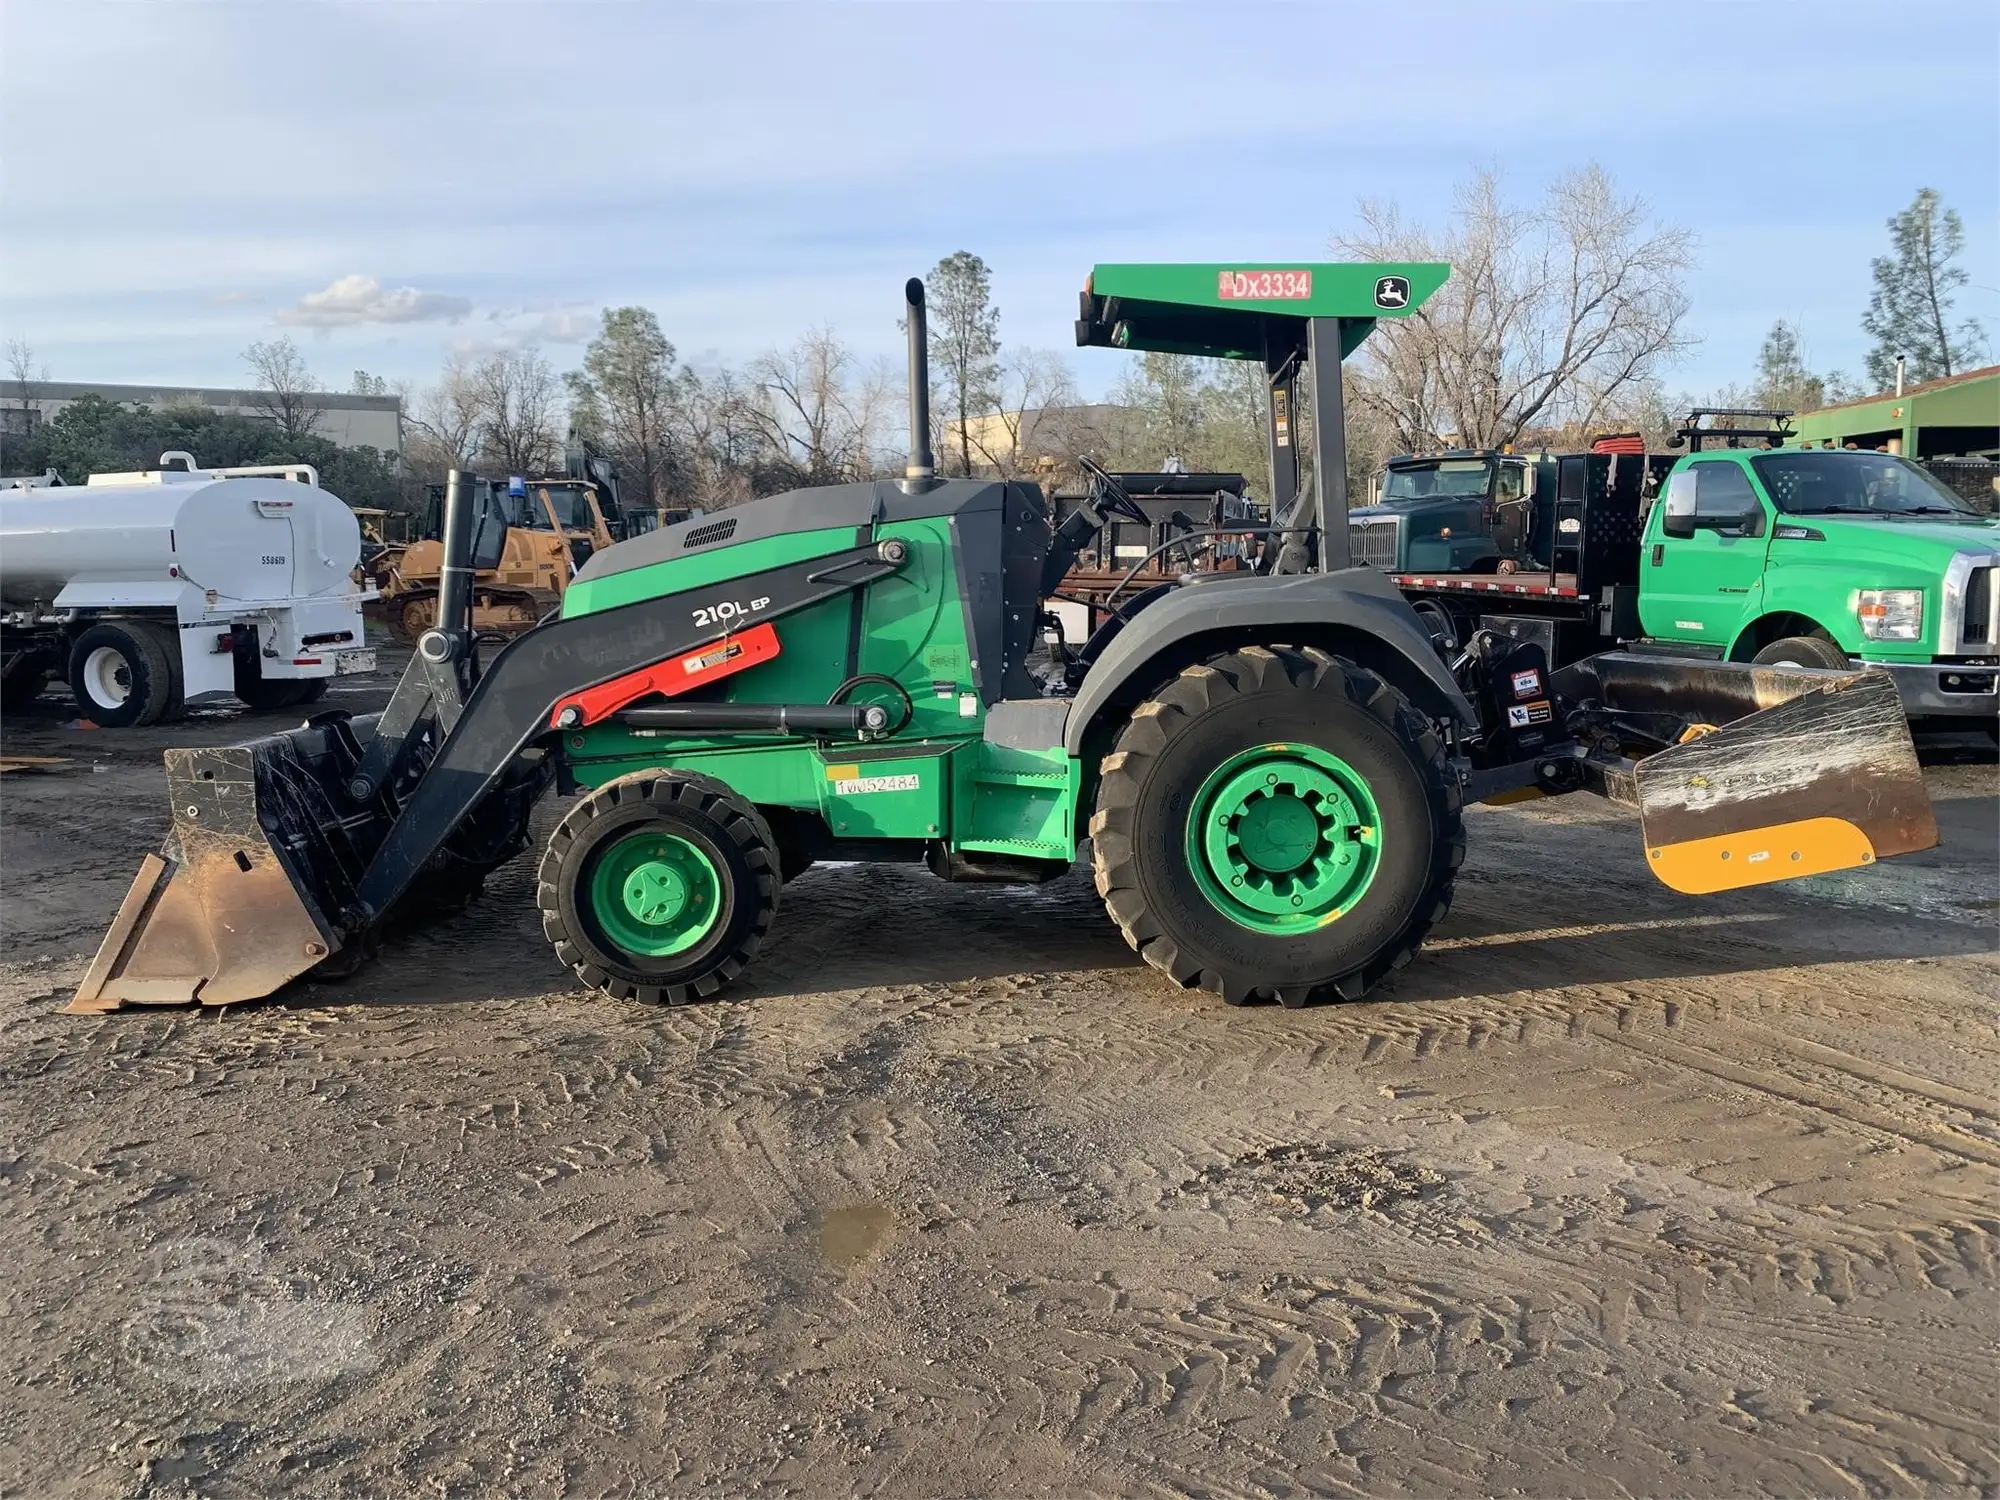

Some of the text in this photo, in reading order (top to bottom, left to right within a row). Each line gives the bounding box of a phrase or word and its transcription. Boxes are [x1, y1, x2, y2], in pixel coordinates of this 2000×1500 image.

[261, 555, 285, 565] 558619
[692, 596, 771, 628] 210L EP
[838, 775, 918, 794] 10052484
